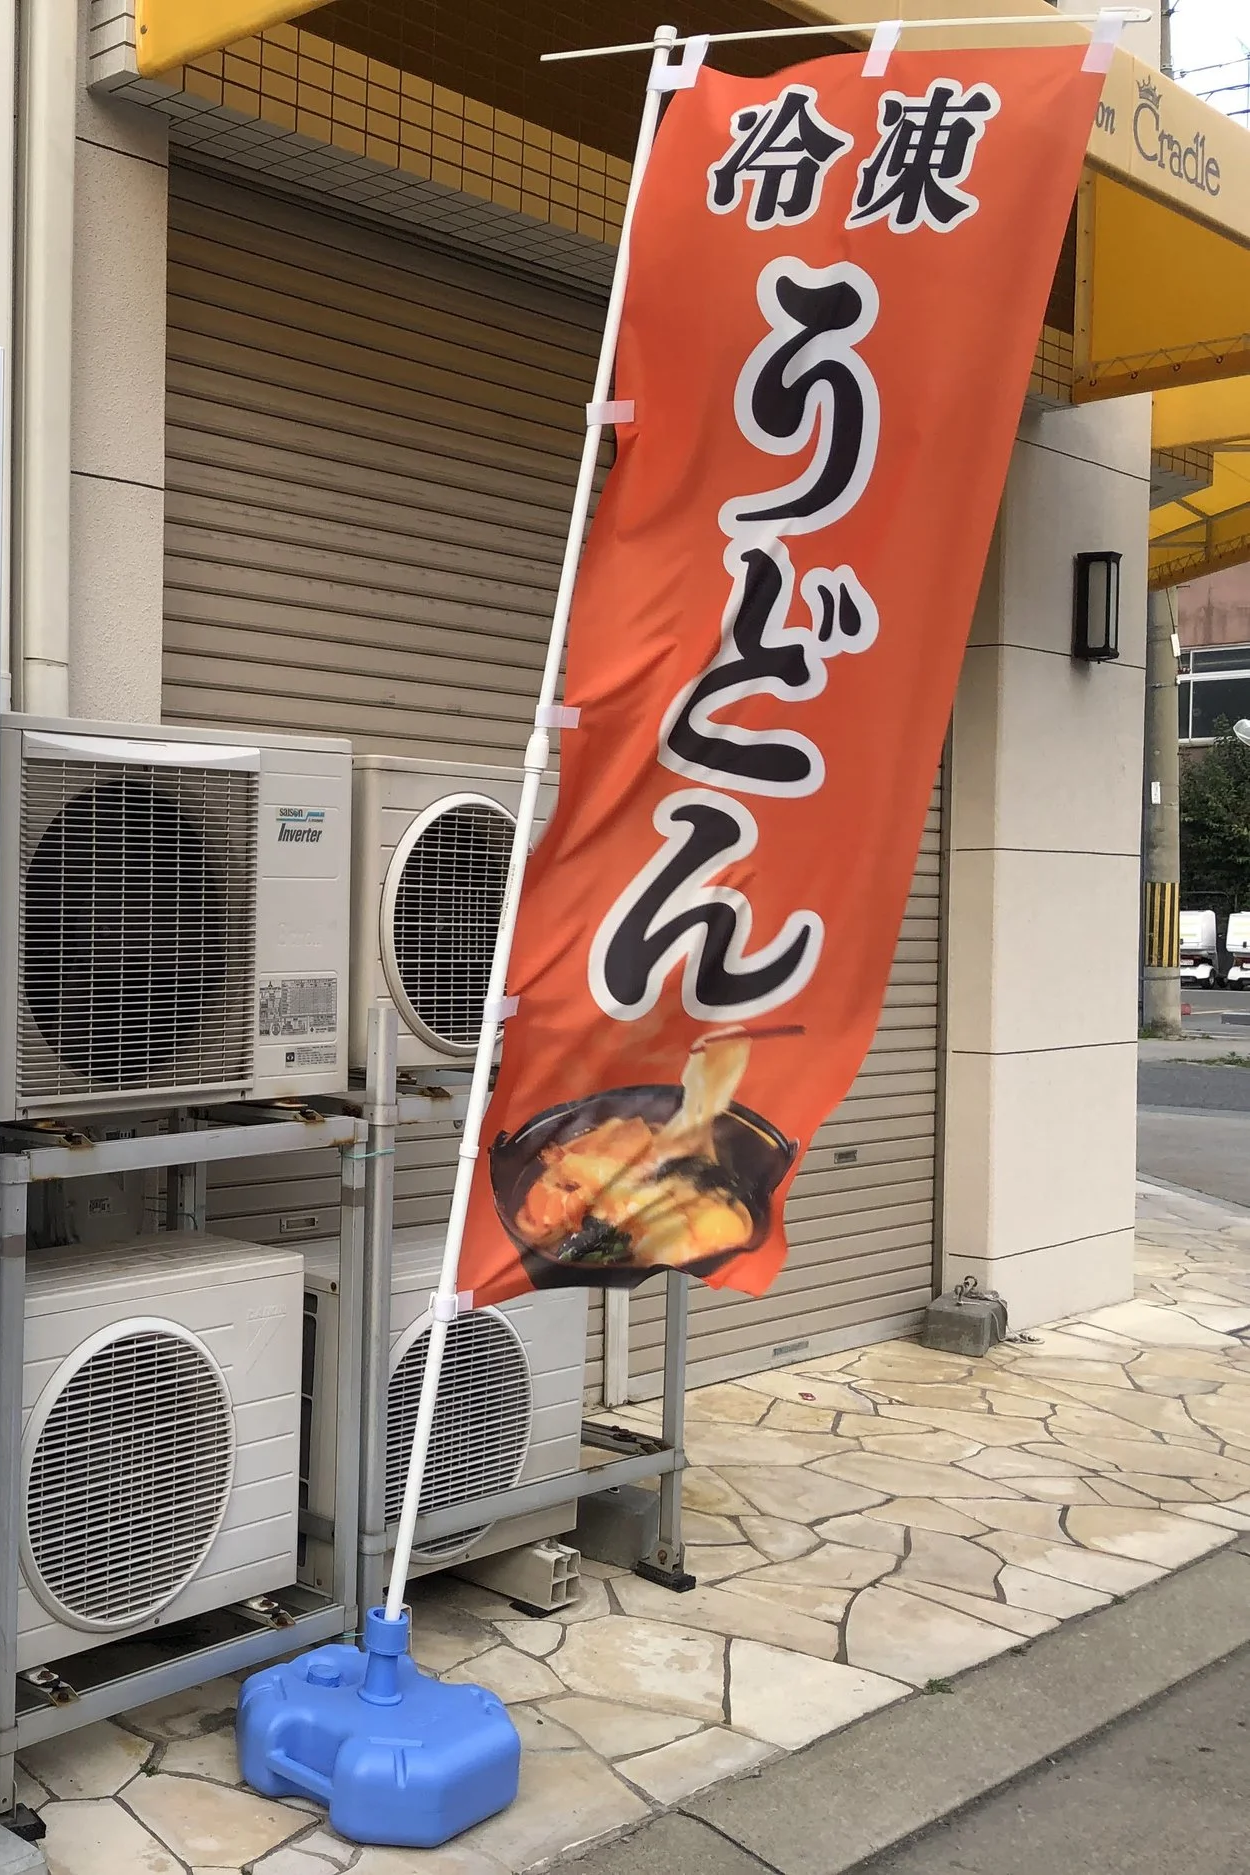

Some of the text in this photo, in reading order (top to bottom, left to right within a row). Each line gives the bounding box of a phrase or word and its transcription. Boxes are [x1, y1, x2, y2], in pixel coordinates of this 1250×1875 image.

[708, 82, 998, 231] 冷凍
[1133, 102, 1221, 196] Cradle
[595, 264, 870, 1014] うどん
[277, 822, 323, 843] Inverter
